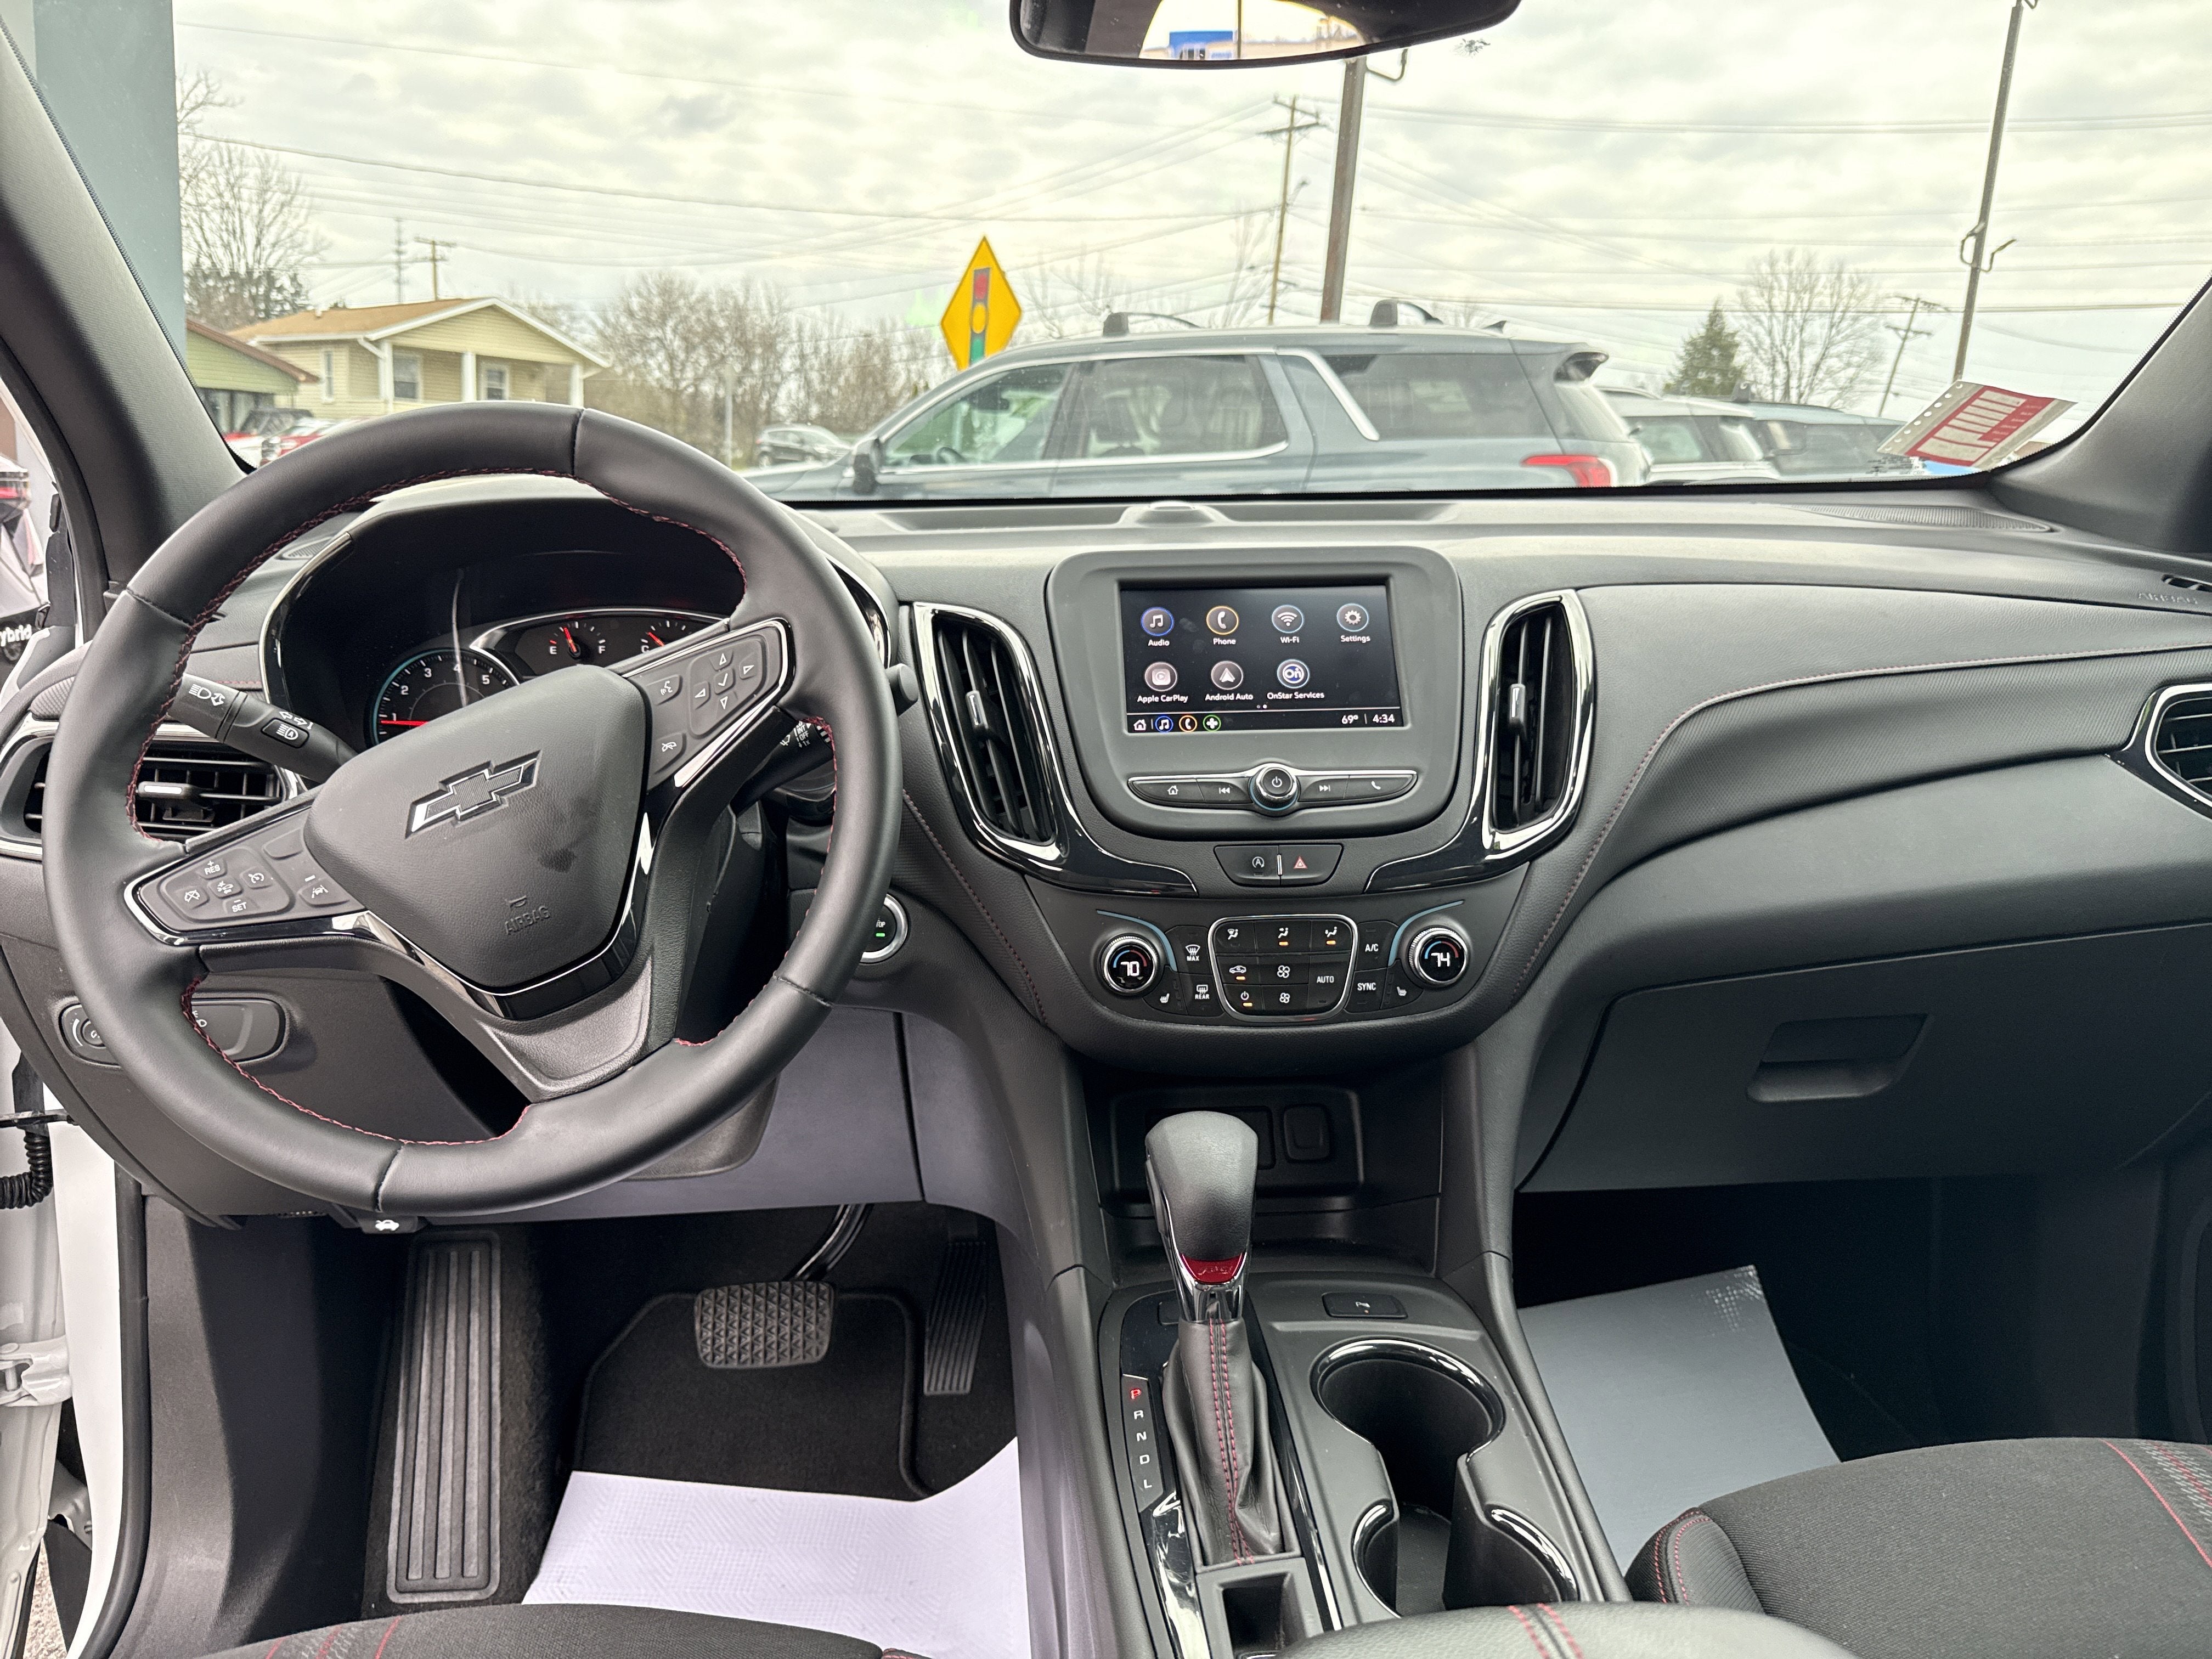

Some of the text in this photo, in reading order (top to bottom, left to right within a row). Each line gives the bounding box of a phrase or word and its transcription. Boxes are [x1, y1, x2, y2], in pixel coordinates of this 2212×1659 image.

[0, 624, 32, 647] ybrid
[1340, 635, 1371, 644] Settings
[550, 646, 557, 654] E
[599, 646, 606, 654] F
[424, 668, 432, 678] 3
[453, 664, 461, 673] 4
[482, 675, 490, 685] 5
[401, 685, 409, 696] 2
[1137, 695, 1188, 704] Apple CarPlay
[392, 713, 397, 721] 1
[1372, 714, 1395, 723] 4:34
[799, 730, 809, 741] OFF
[204, 864, 221, 875] RES
[232, 901, 247, 912] SET
[504, 906, 550, 935] AIRBAG
[1364, 943, 1379, 952] A/C
[1431, 952, 1451, 967] 74
[1120, 961, 1139, 977] 70
[1357, 982, 1376, 991] SYNC
[1131, 1389, 1142, 1400] P
[1134, 1409, 1144, 1419] R
[1137, 1432, 1147, 1442] N
[1139, 1454, 1150, 1465] D
[1144, 1480, 1152, 1489] L
